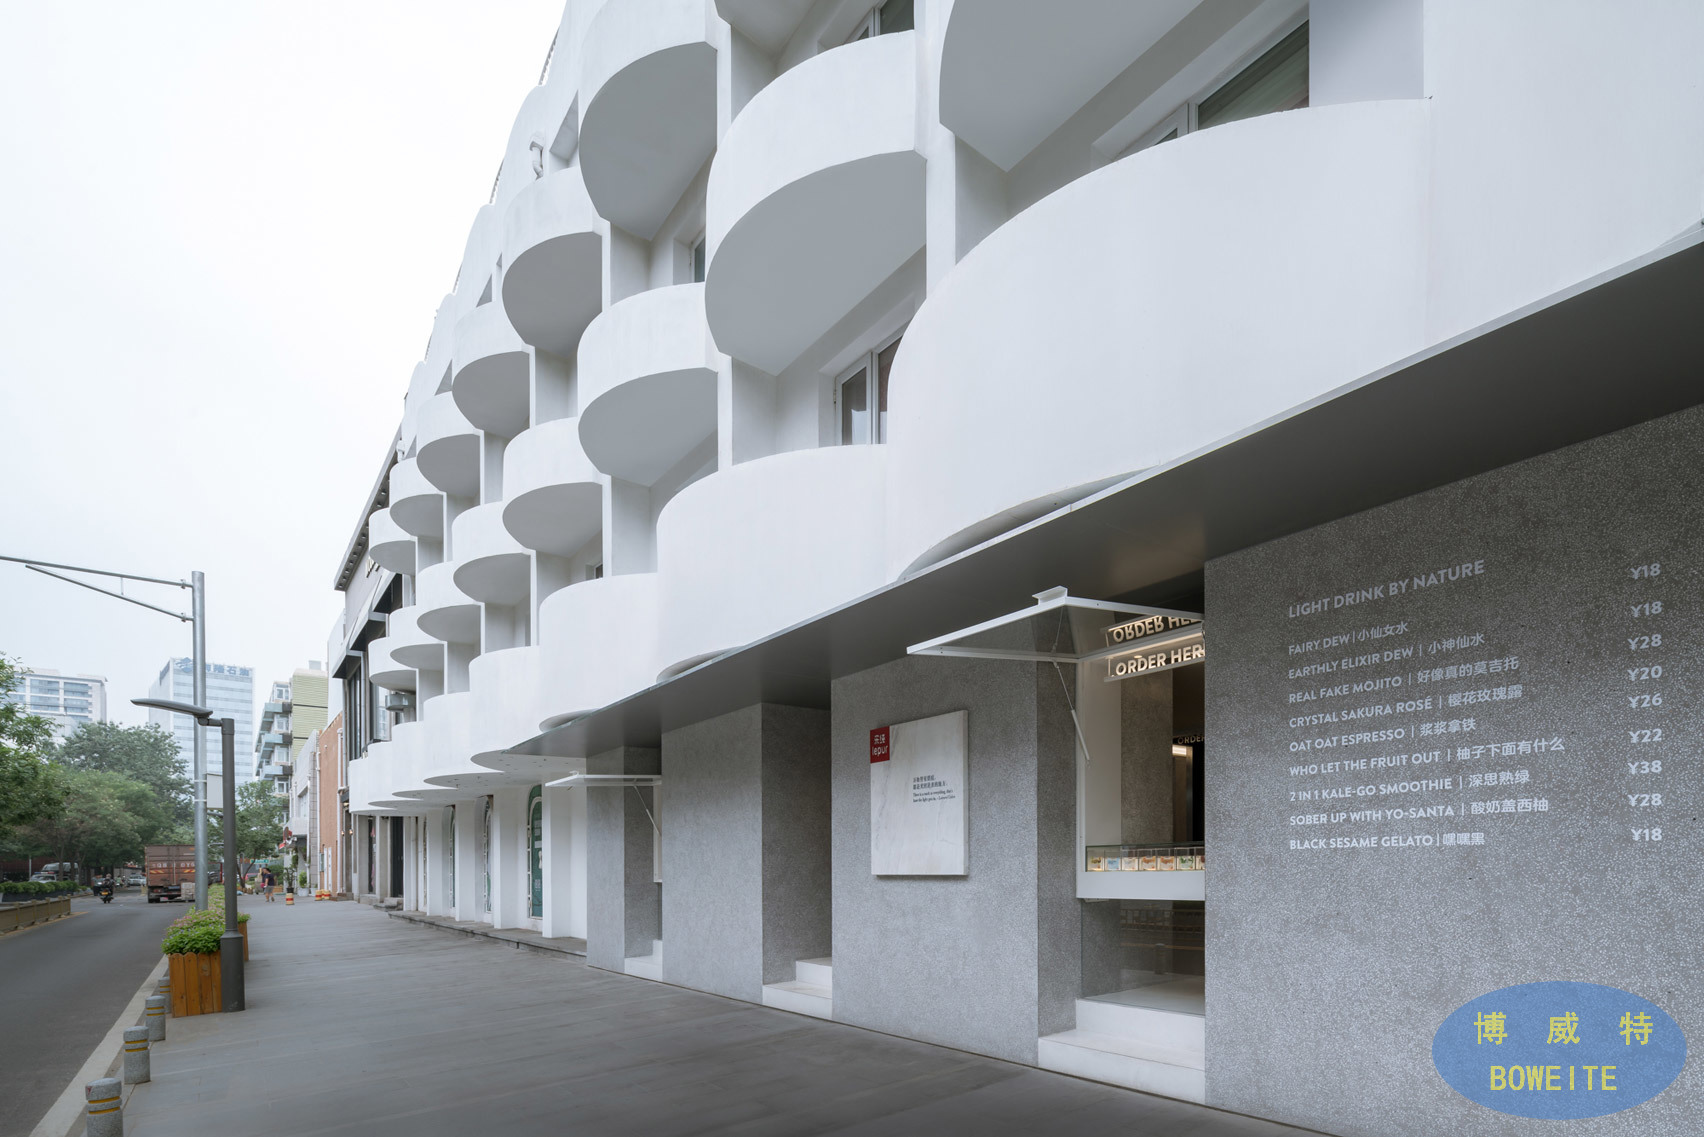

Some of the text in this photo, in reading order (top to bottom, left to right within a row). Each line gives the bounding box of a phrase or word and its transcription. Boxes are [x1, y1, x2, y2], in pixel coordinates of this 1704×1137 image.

[1630, 563, 1661, 580] ¥18
[1289, 560, 1485, 618] LIGHT DRINK BY NATURE
[1630, 601, 1663, 618] ¥18
[1288, 621, 1409, 656] FAIRY DEW 小仙女水
[1627, 633, 1662, 651] ¥28
[1115, 652, 1167, 676] ORDER
[1288, 632, 1485, 679] EARTHLY ELIXIR DEW 小神仙水
[1289, 656, 1519, 703] REAL FAKE MOJITO 好像真的莫吉托
[1627, 665, 1663, 682] ¥20
[1289, 684, 1523, 728] CRYSTAL SAKURA ROSÉ 樱花玫瑰露
[1628, 693, 1663, 709] ¥26
[1289, 740, 1312, 752] OAT
[1315, 736, 1339, 749] OAT
[1341, 728, 1406, 746] ESPRESSO
[1629, 728, 1663, 744] ¥22
[1289, 736, 1566, 776] WHO LET THE FRUIT OUT 柚子下面有什么
[1627, 759, 1663, 775] ¥38
[1290, 769, 1531, 801] 2 IN 1 KALE-GO SMOOTHIE 深思熟绿
[1627, 793, 1663, 807] ¥28
[1290, 798, 1549, 826] SOBER UP WITH YO-SANTA 酸奶盖西柚
[1290, 838, 1327, 850] BLACK
[1329, 836, 1379, 849] SESAME
[1381, 834, 1433, 848] GELATO
[1630, 827, 1663, 841] ¥18
